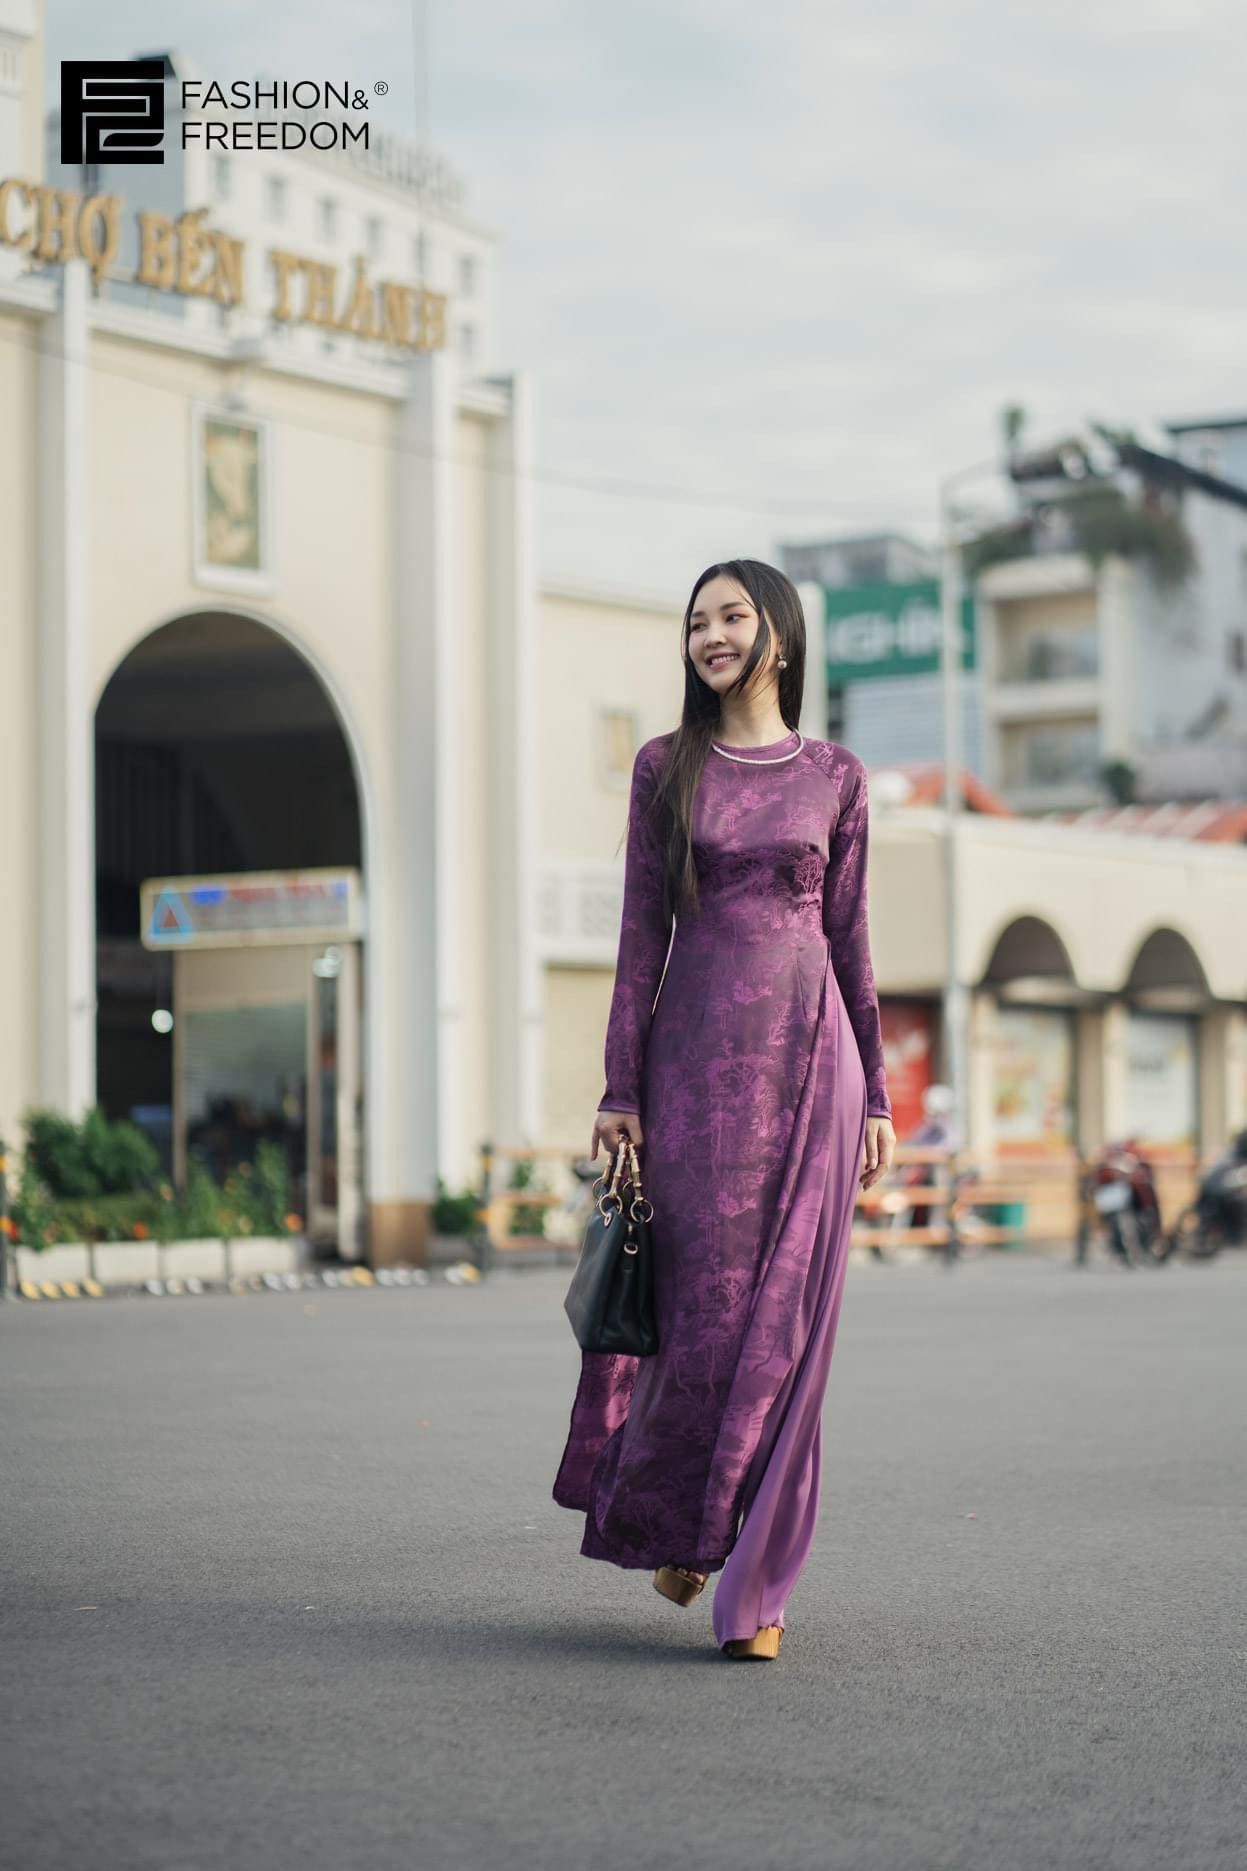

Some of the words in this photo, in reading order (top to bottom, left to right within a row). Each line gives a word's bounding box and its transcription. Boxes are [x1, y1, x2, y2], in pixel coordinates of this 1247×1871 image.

[0, 179, 118, 296] CHỢ
[136, 208, 246, 306] BẾN
[270, 249, 449, 351] THÀNH
